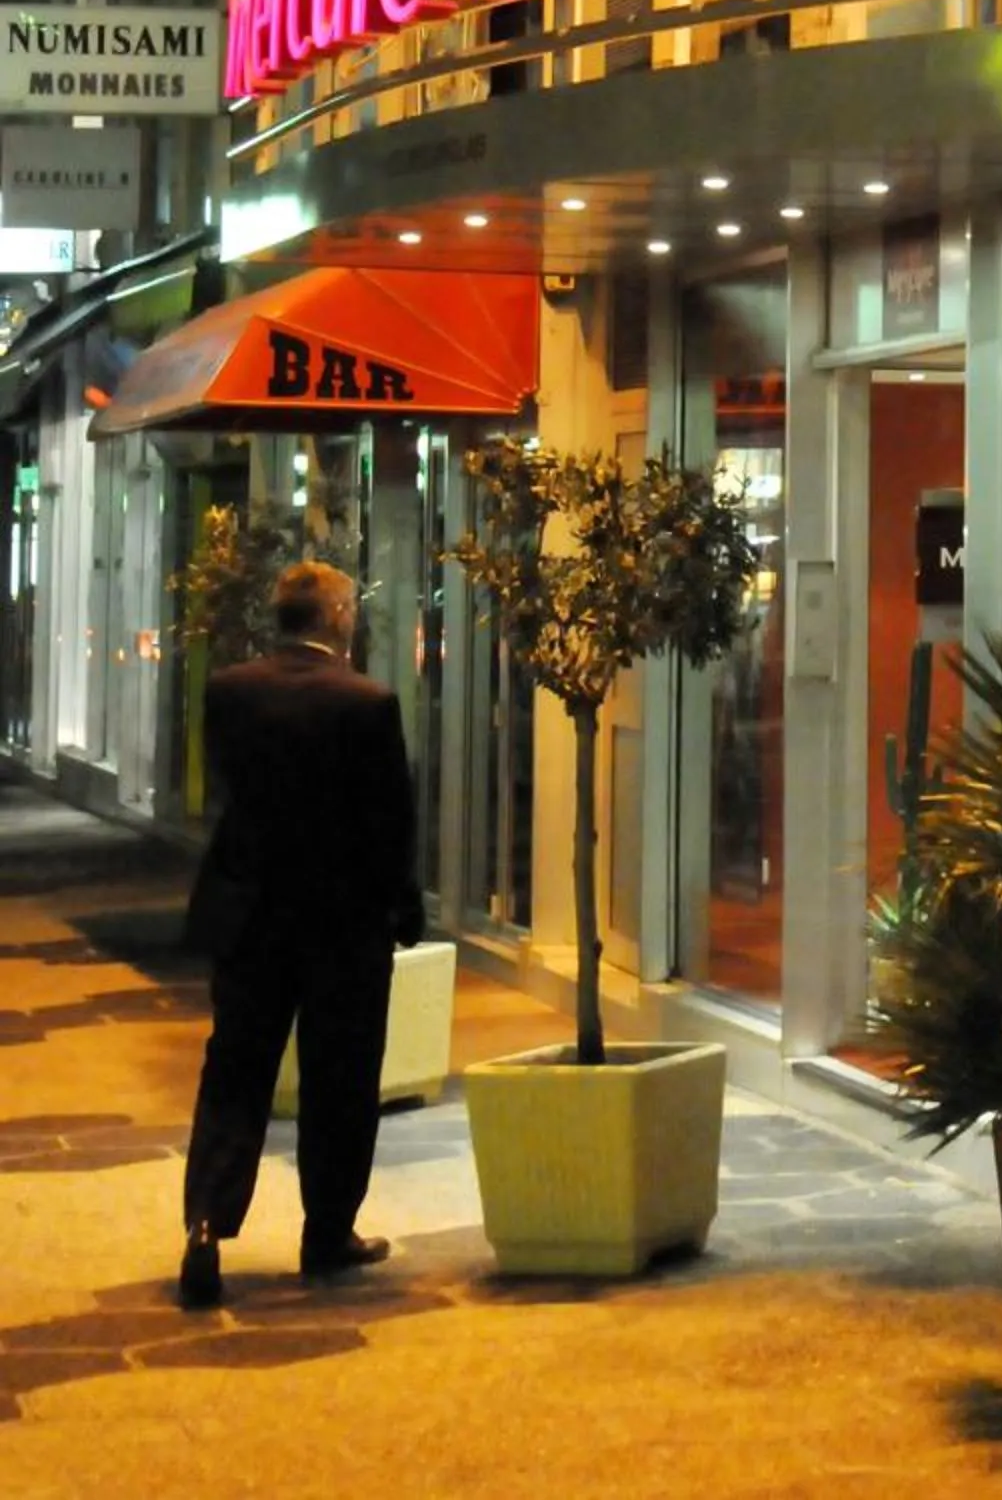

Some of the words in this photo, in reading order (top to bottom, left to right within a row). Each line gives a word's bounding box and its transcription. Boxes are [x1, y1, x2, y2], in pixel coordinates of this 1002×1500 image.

[8, 22, 207, 57] NUMISAMI
[29, 72, 186, 98] MONNAIES
[268, 328, 415, 402] BAR
